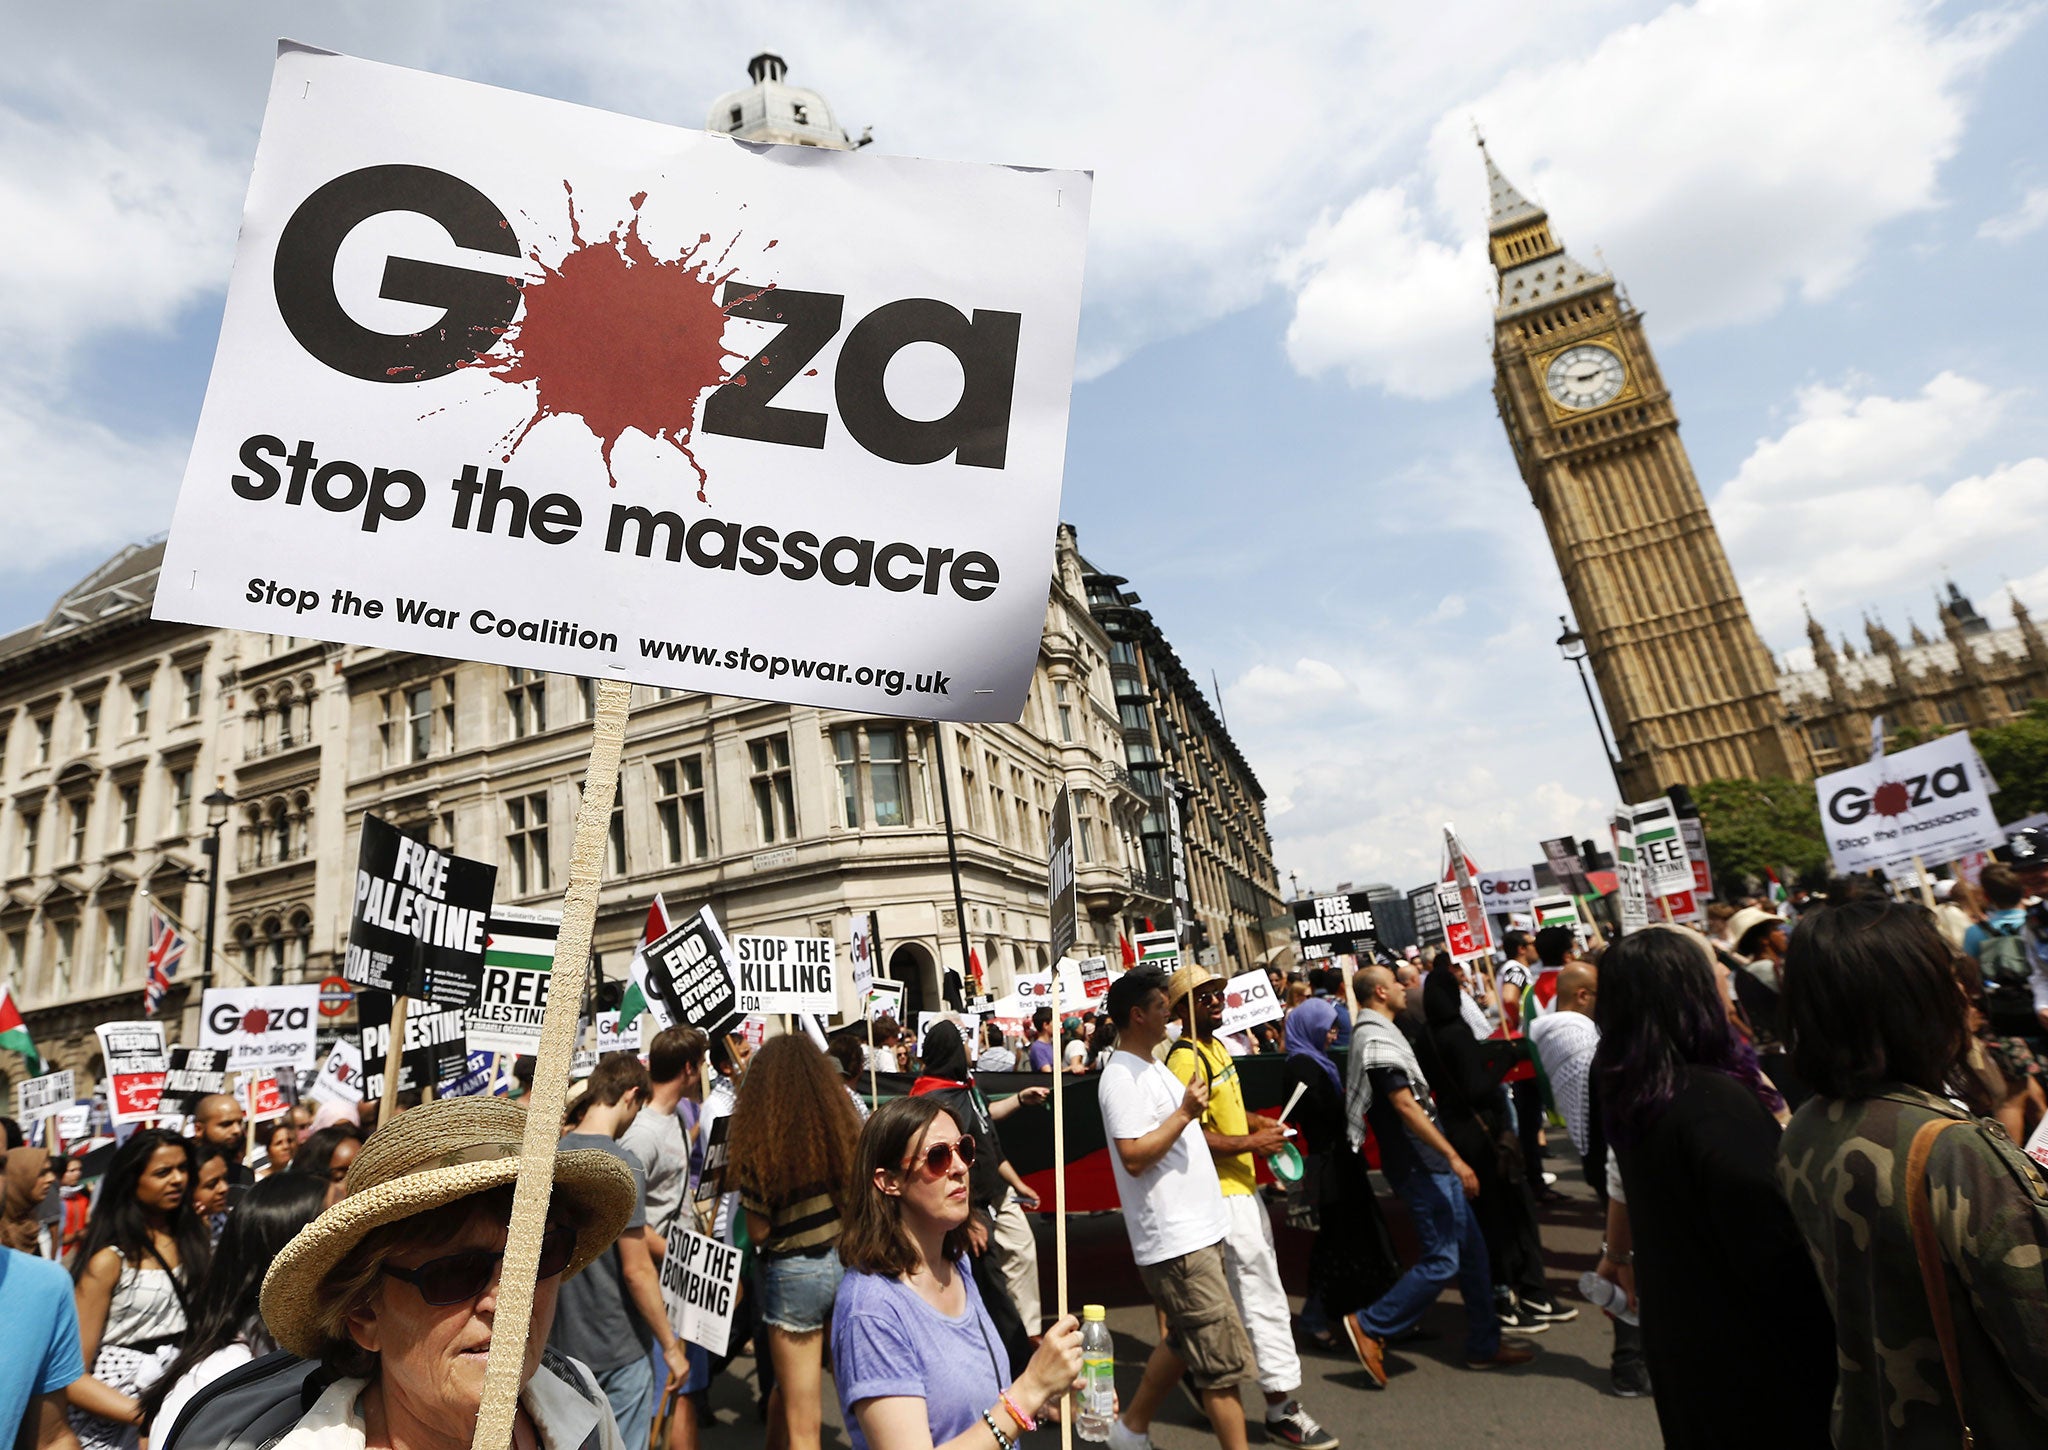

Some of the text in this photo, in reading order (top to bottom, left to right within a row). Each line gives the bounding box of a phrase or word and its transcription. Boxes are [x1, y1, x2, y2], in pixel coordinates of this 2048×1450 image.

[231, 434, 1001, 602] Stop the massacre
[245, 578, 952, 696] Stop the War Coalition www.stopwar.org.uk
[1836, 832, 1870, 852] Stop
[1874, 828, 1899, 842] the
[1902, 806, 1981, 835] massacre
[393, 836, 450, 900] FREE
[1637, 838, 1684, 866] REE
[353, 869, 487, 954] PALESTINE
[1298, 911, 1375, 939] PALESTINE
[1314, 895, 1352, 918] FREE
[662, 933, 708, 980] END
[739, 938, 787, 962] STOP
[795, 939, 831, 963] THE
[1304, 944, 1322, 960] FOA
[484, 968, 552, 1007] REE
[671, 954, 718, 996] ISRAEL'S
[680, 968, 725, 1011] ATTACKS
[740, 963, 832, 993] KILLING
[468, 1005, 546, 1026] ALESTIN
[686, 1003, 706, 1025] ON
[705, 984, 733, 1012] GAZA
[741, 996, 760, 1011] FOA
[238, 1041, 307, 1057] the siege
[362, 1008, 465, 1061] PAESTINE
[668, 1224, 737, 1284] STOP THE
[662, 1257, 730, 1318] BOMBING
